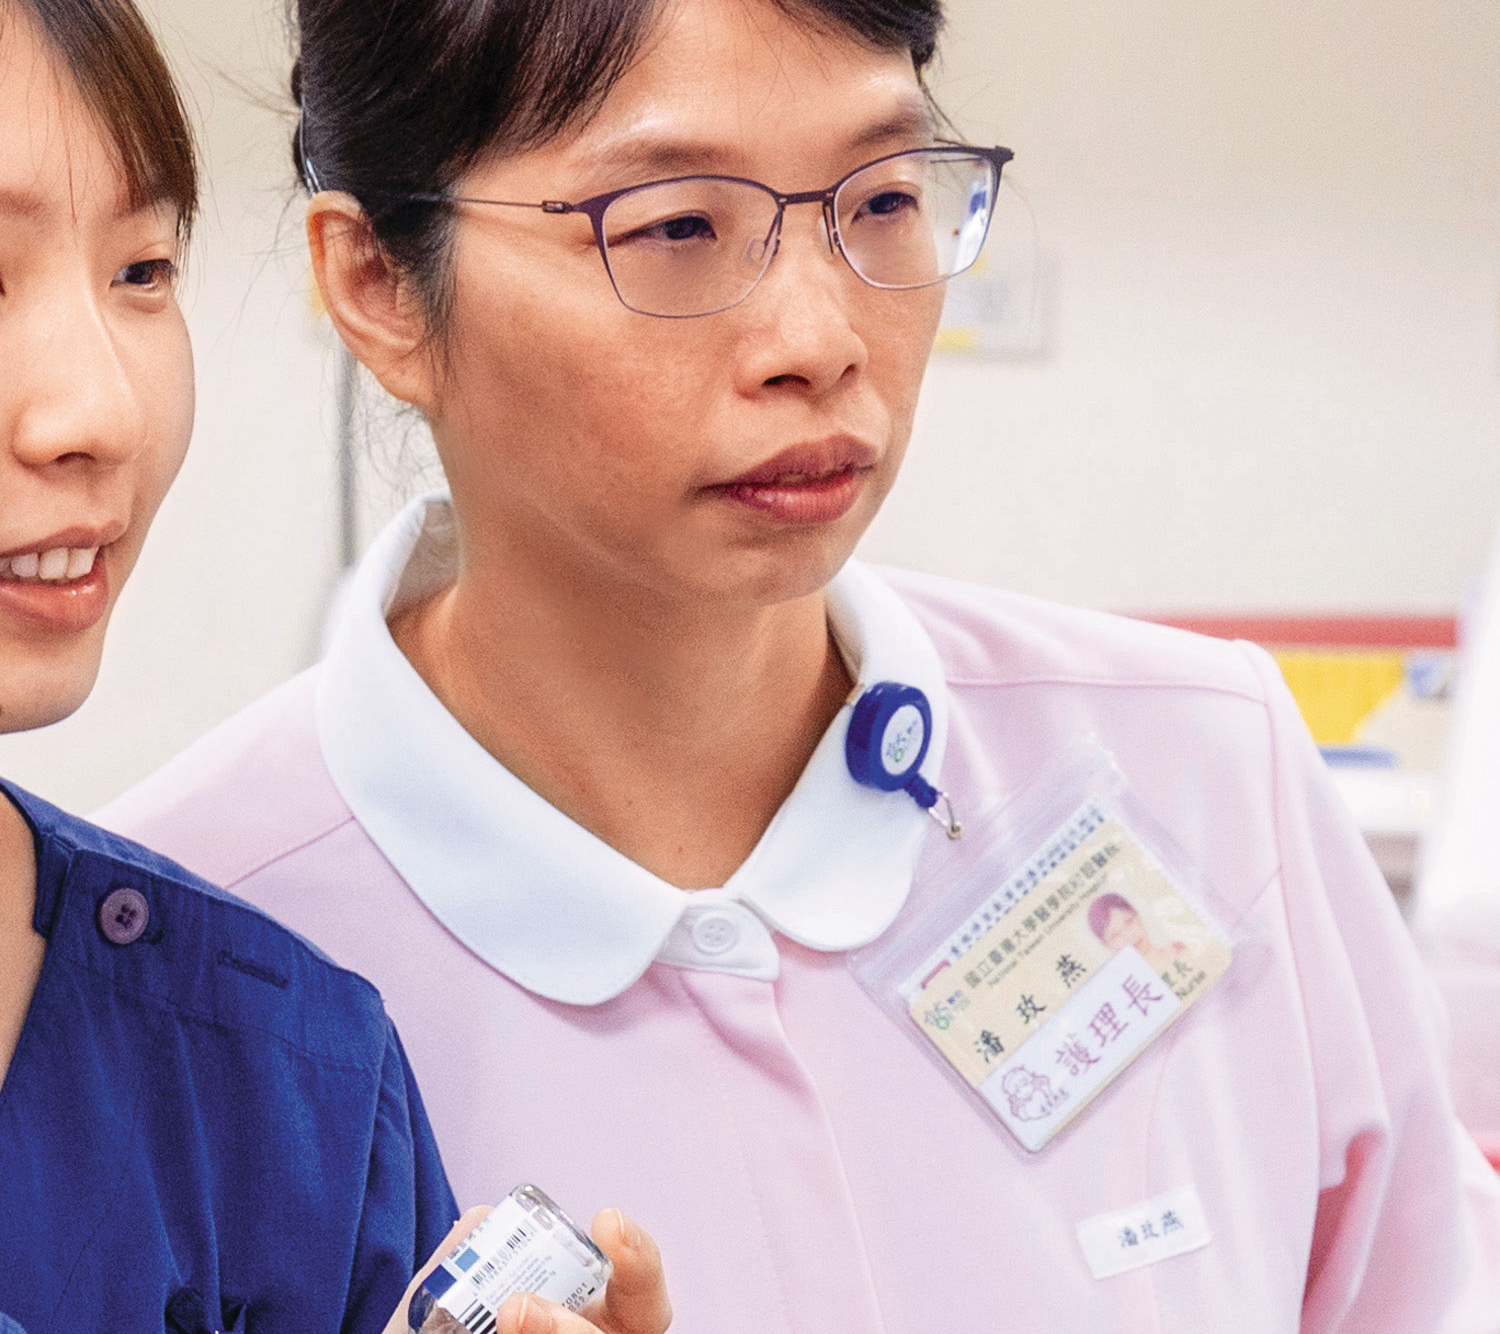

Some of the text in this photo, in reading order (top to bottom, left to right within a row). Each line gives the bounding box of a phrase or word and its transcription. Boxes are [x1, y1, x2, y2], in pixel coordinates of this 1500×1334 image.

[974, 953, 1087, 1064] 潘玫燕
[1055, 974, 1165, 1076] 護理長
[1117, 1210, 1184, 1248] 潘玫燕
